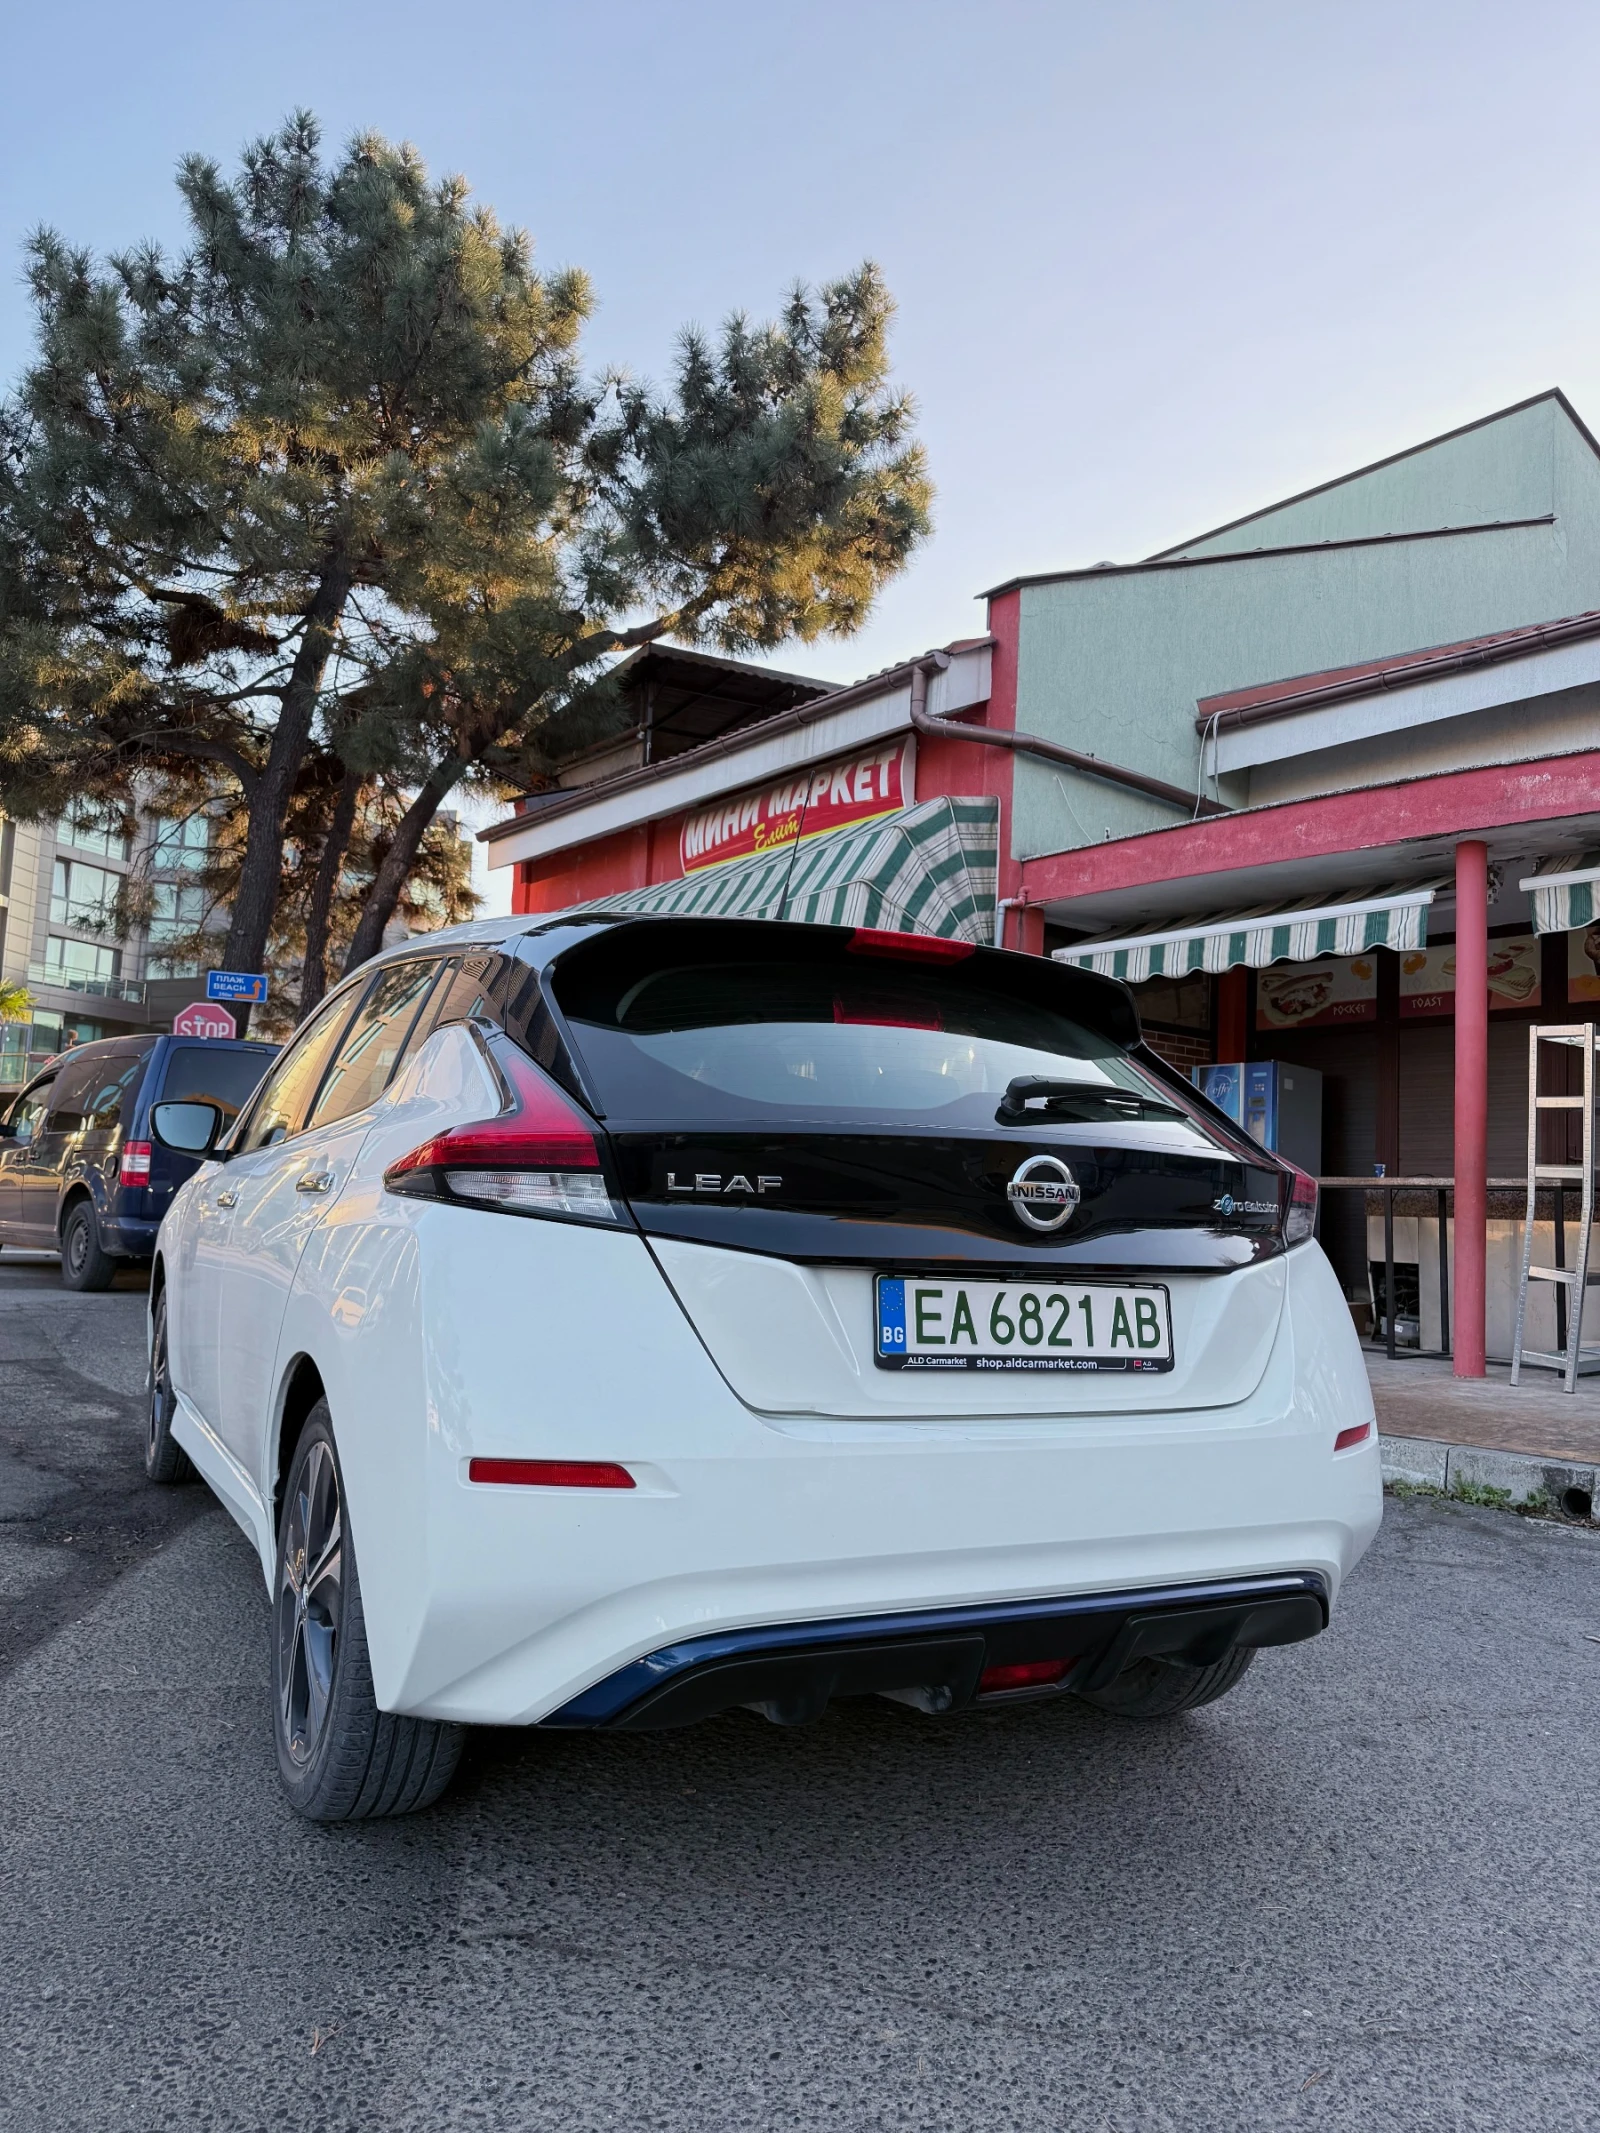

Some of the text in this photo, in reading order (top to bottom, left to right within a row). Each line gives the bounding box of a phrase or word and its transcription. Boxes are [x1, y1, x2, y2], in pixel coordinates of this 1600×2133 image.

[685, 747, 898, 859] МИНИ МАРКЕТ
[754, 813, 800, 851] Елит
[216, 975, 245, 984] ПЛАЖ
[213, 982, 246, 992] BEACH
[1412, 995, 1443, 1008] TOAST
[1333, 1003, 1366, 1016] POCKET
[181, 1020, 230, 1038] STOP
[667, 1172, 783, 1193] LEAF
[1017, 1186, 1075, 1200] NISSAN
[914, 1289, 1161, 1349] EA 6821 AB
[882, 1326, 904, 1343] BG
[907, 1357, 967, 1365] ALD Carmarket
[976, 1357, 1098, 1369] shop.aldcarmarket.com
